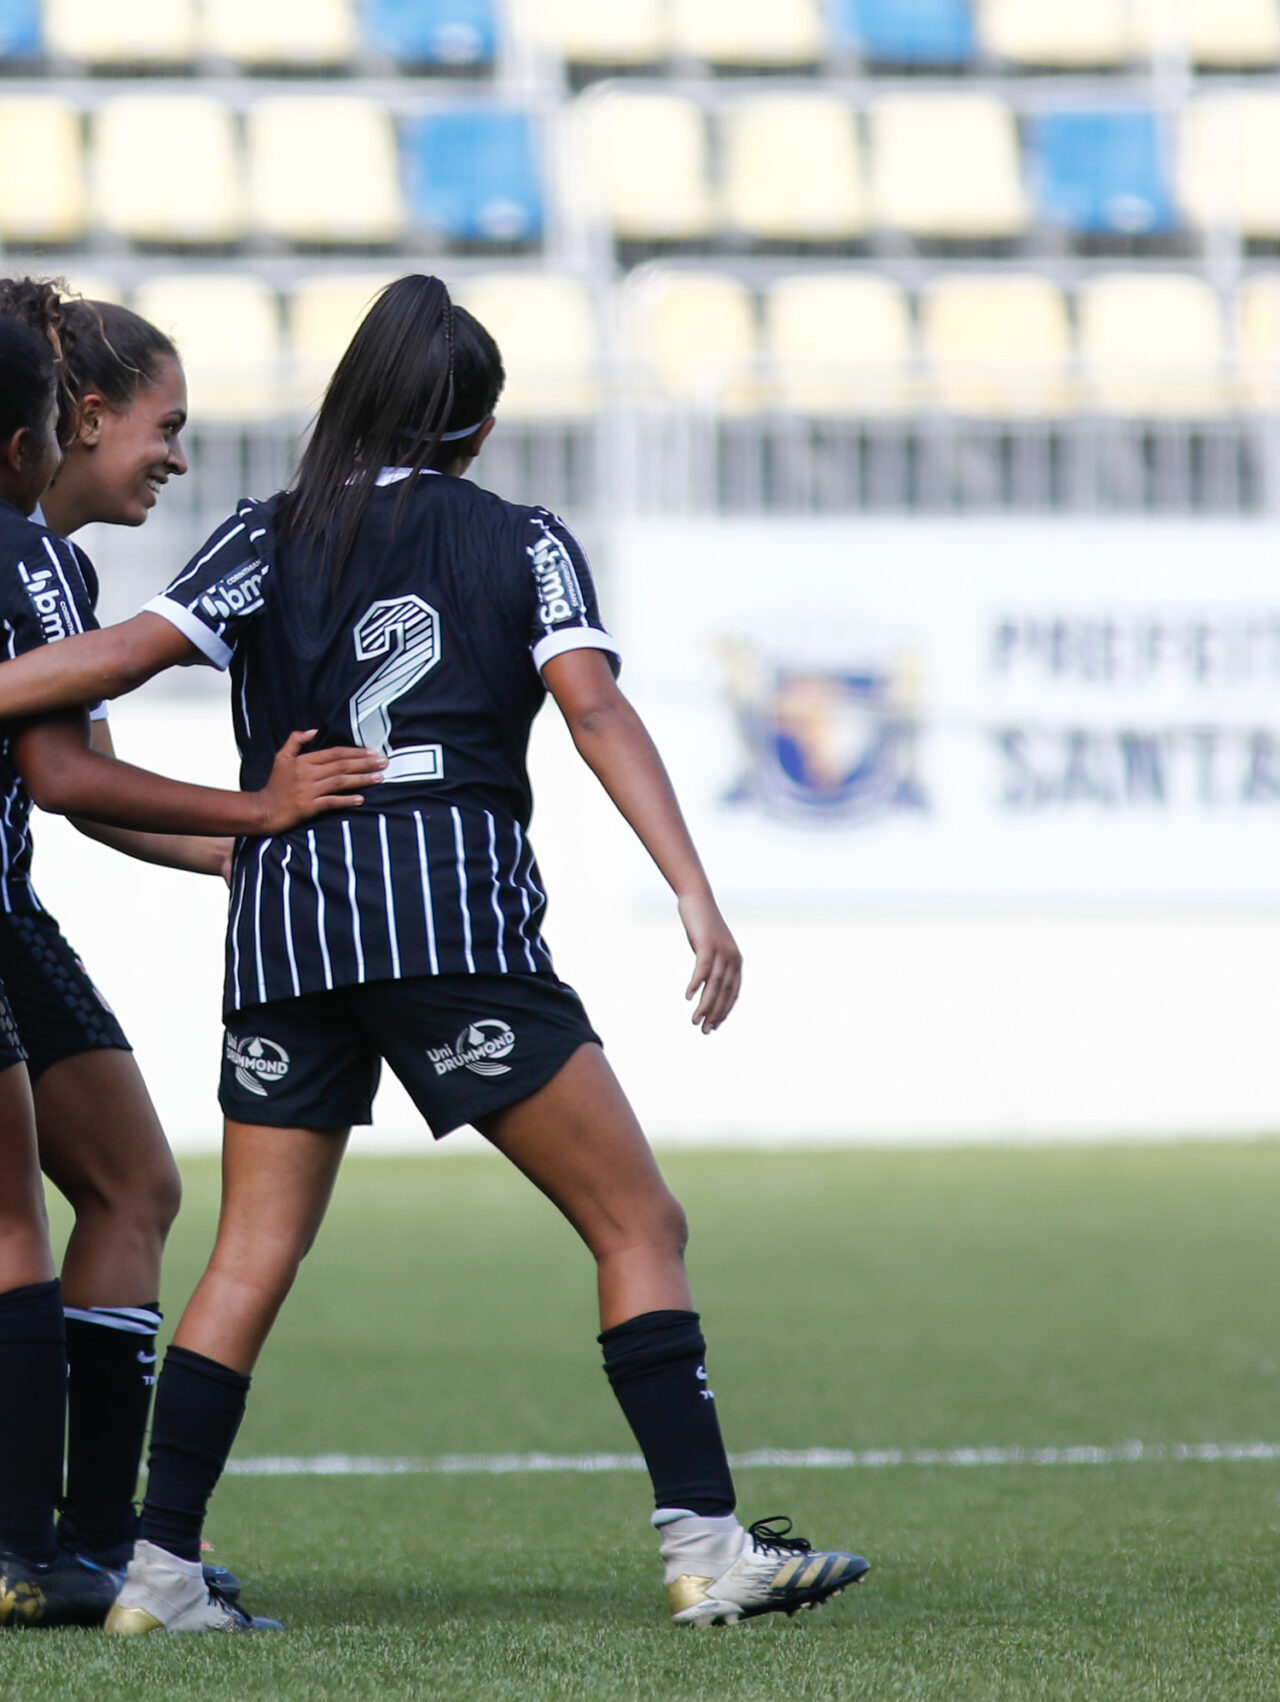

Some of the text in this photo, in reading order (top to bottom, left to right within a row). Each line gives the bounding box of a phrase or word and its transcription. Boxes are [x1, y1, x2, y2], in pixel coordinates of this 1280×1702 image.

[219, 574, 262, 611] bm
[33, 589, 66, 644] bm
[349, 594, 444, 784] 2
[426, 1043, 453, 1063] Uni
[434, 1031, 516, 1076] DRUMMOND
